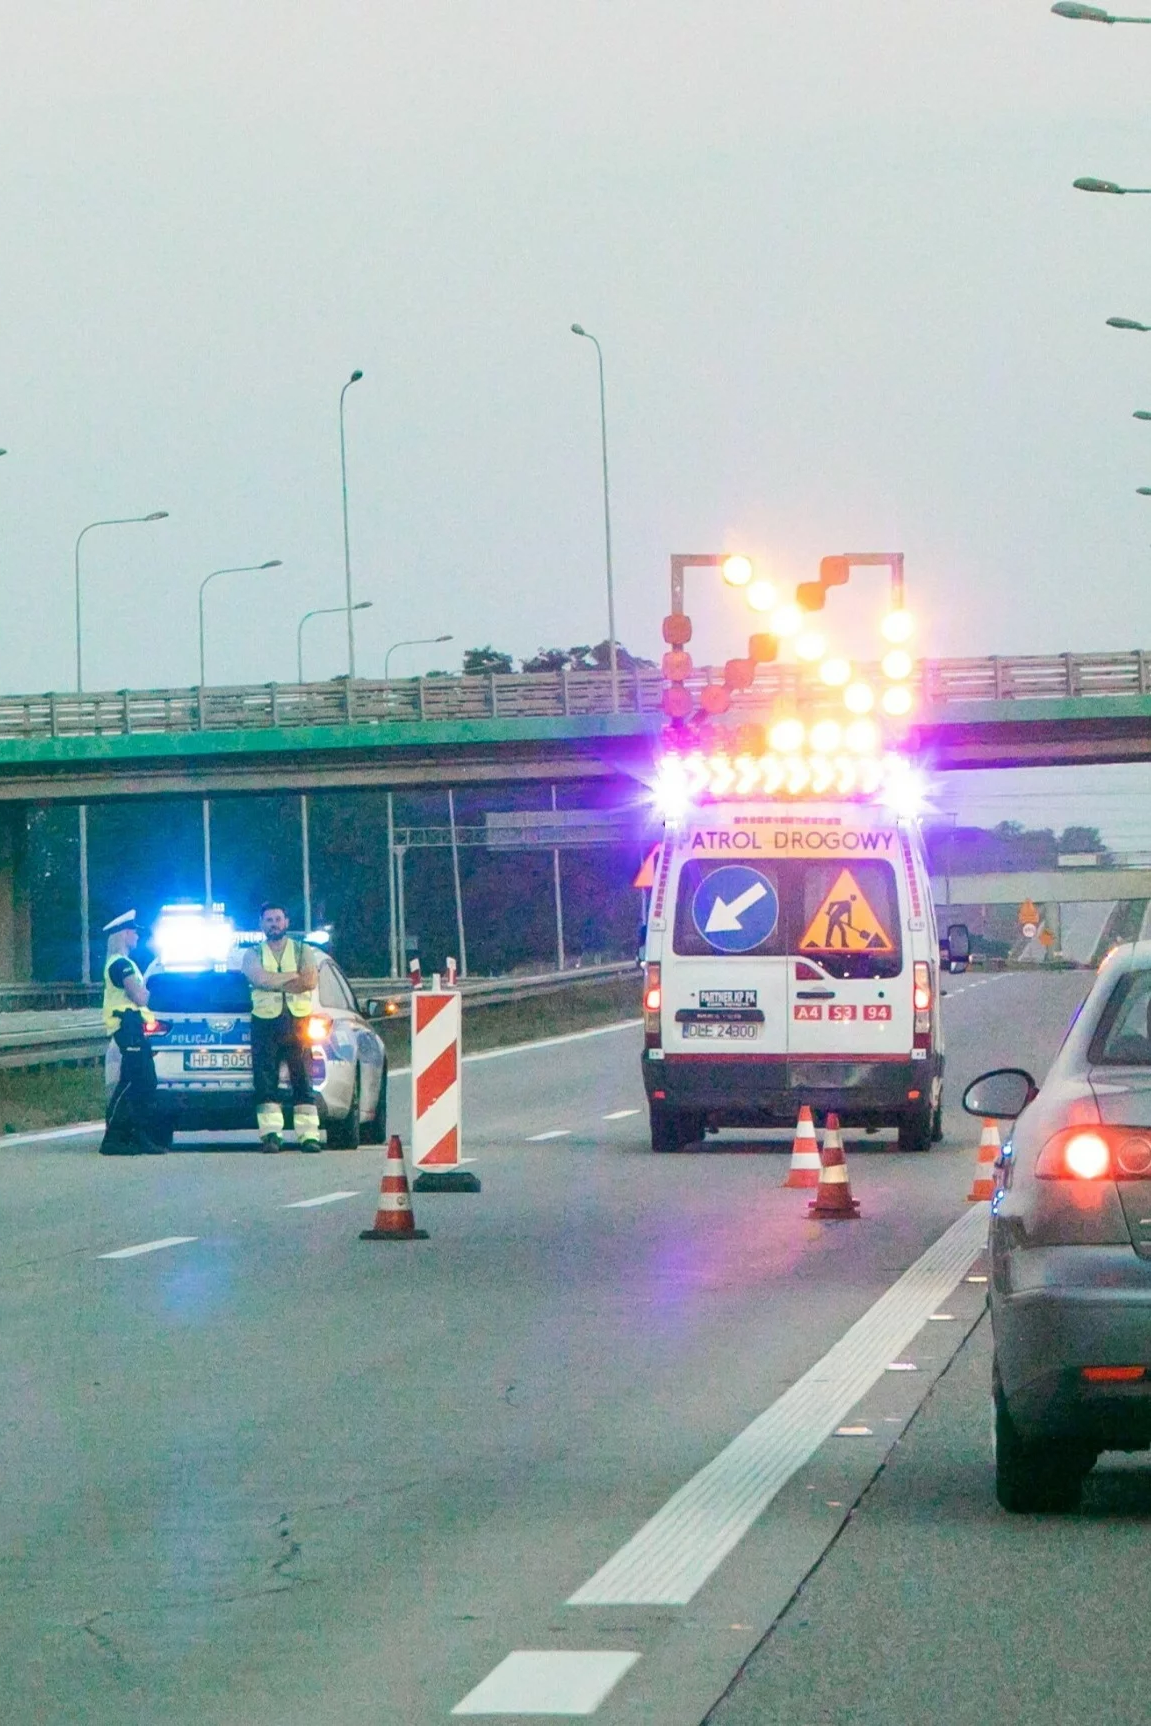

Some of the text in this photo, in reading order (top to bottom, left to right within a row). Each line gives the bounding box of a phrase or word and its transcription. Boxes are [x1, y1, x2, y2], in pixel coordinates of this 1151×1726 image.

[774, 831, 893, 851] DROGOWY
[797, 1006, 819, 1019] A4
[833, 1006, 853, 1019] S3
[867, 1006, 888, 1019] 94
[171, 1033, 215, 1044] POLICJA
